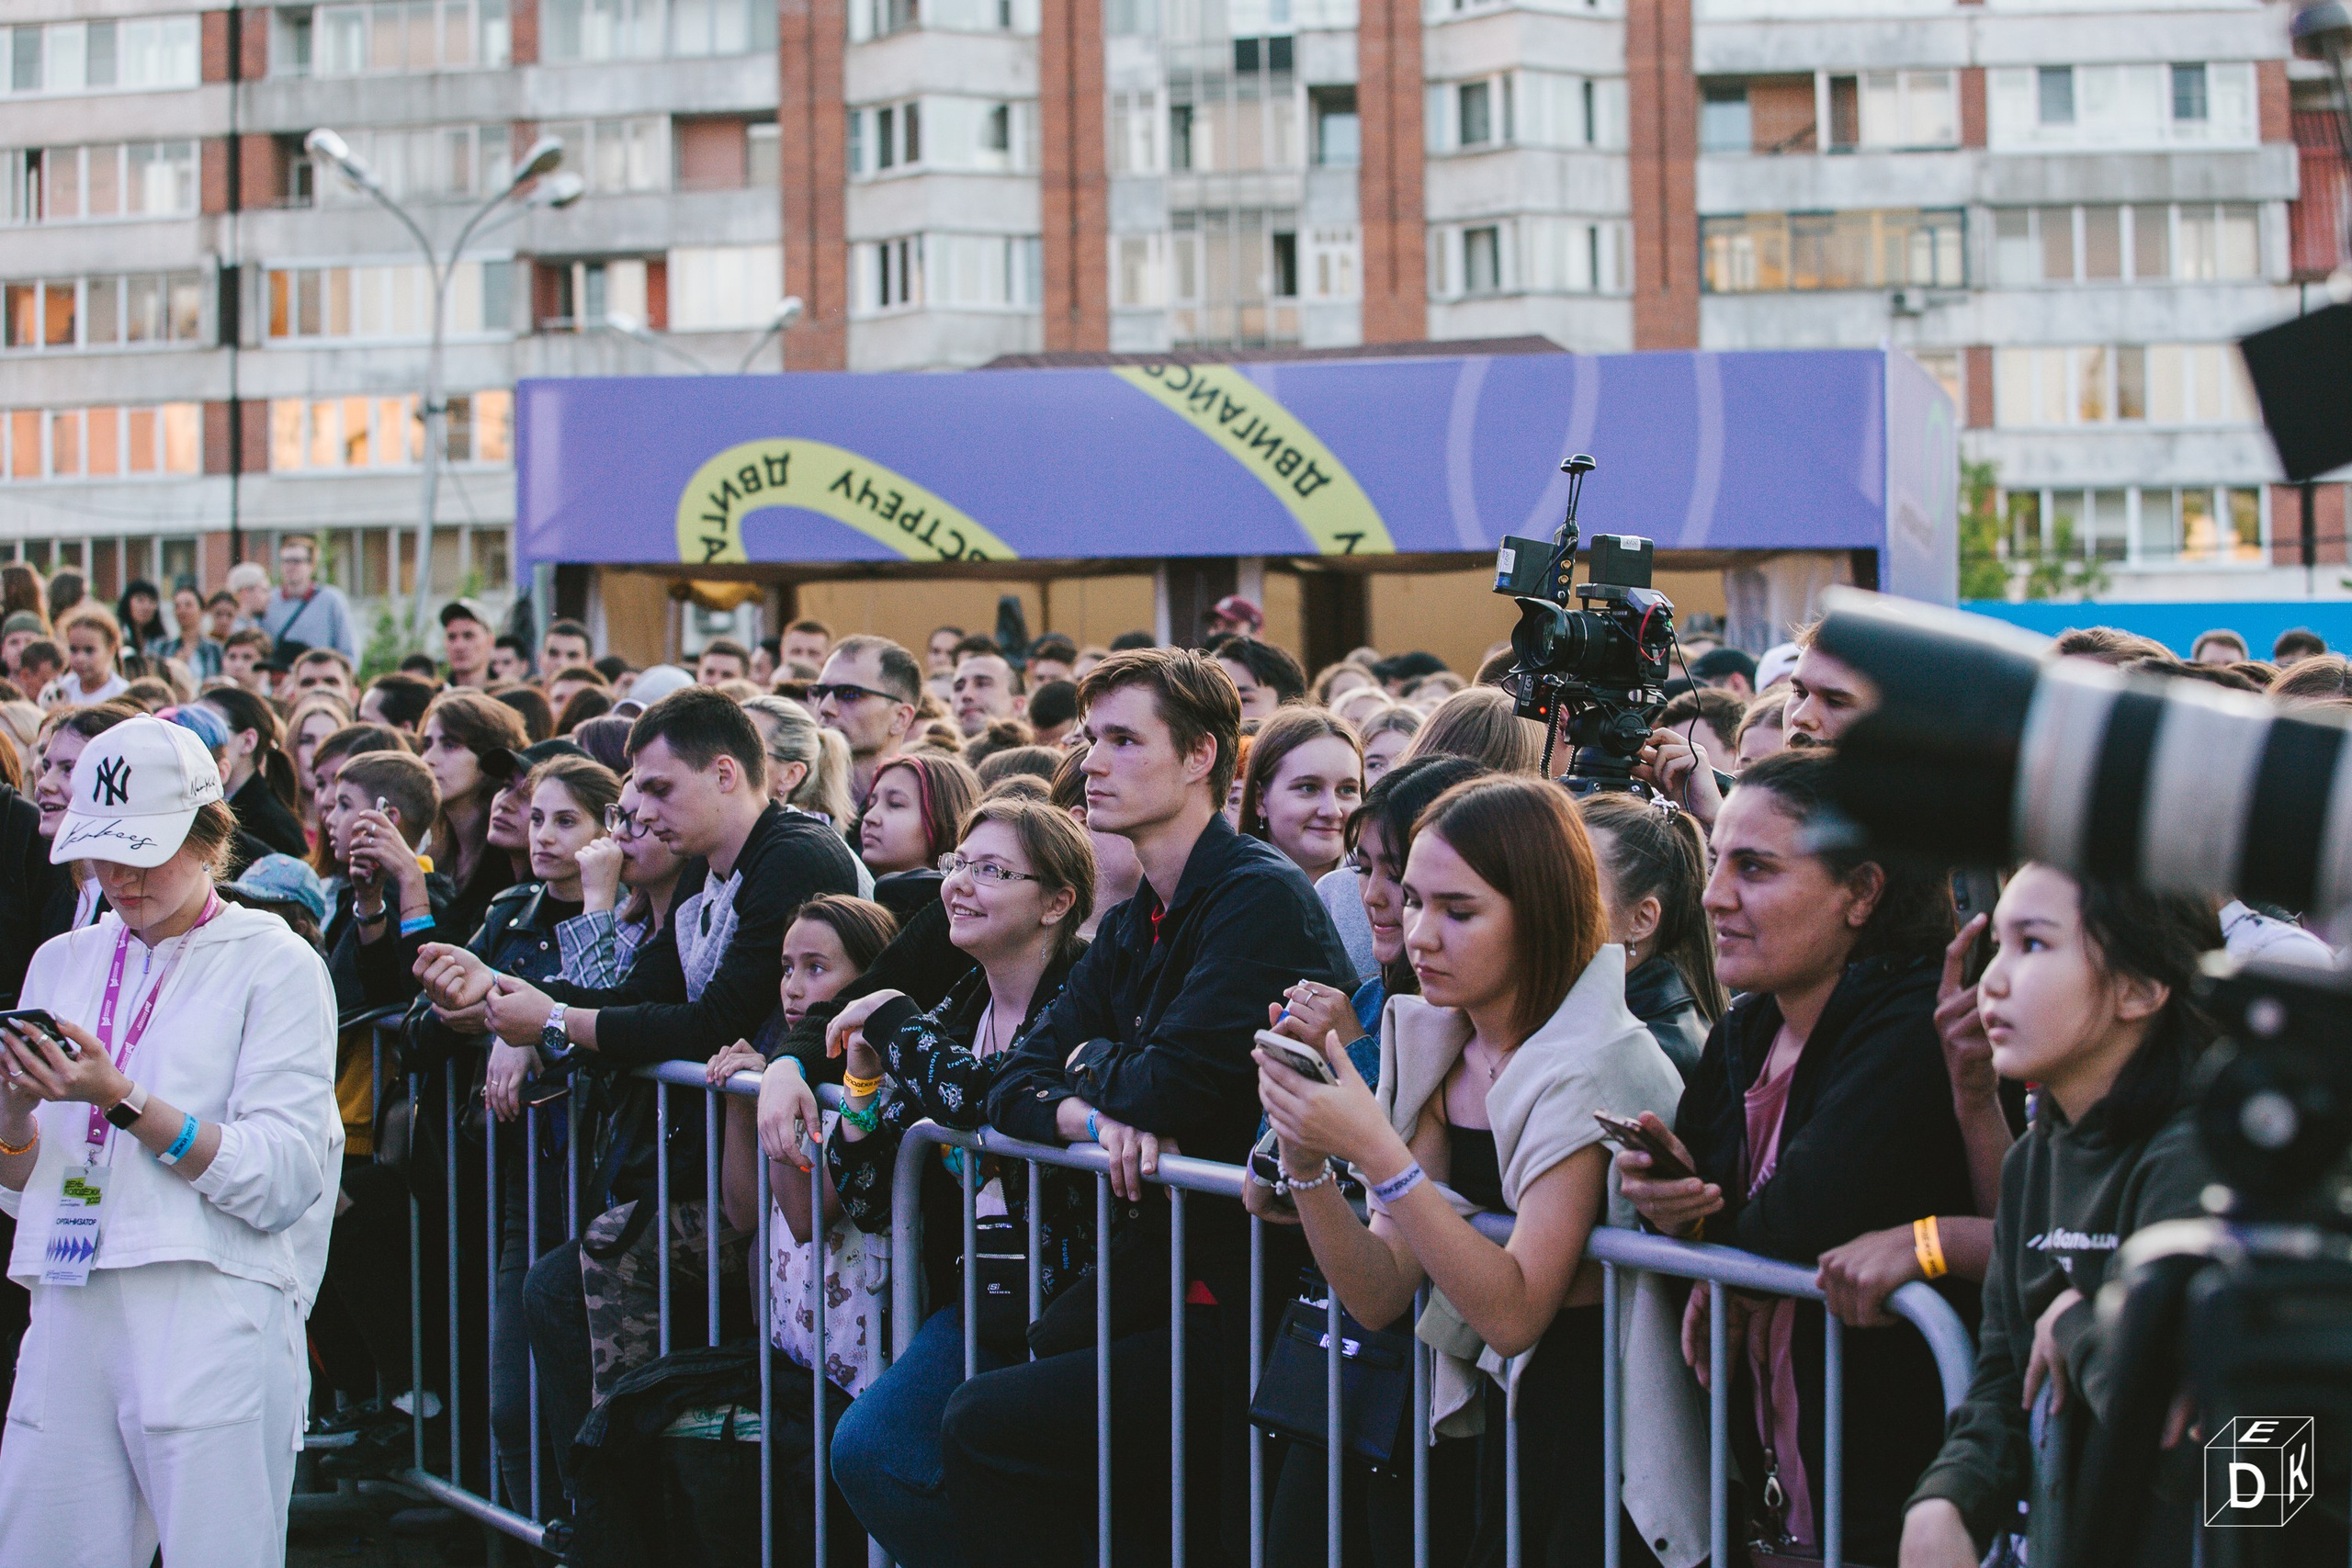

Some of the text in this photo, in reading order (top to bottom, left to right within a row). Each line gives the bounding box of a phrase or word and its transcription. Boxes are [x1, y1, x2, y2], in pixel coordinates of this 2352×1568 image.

[93, 755, 132, 807] NY
[56, 1217, 97, 1226] ОРГАНИЗАТОР
[1062, 1238, 1070, 1270] trouble
